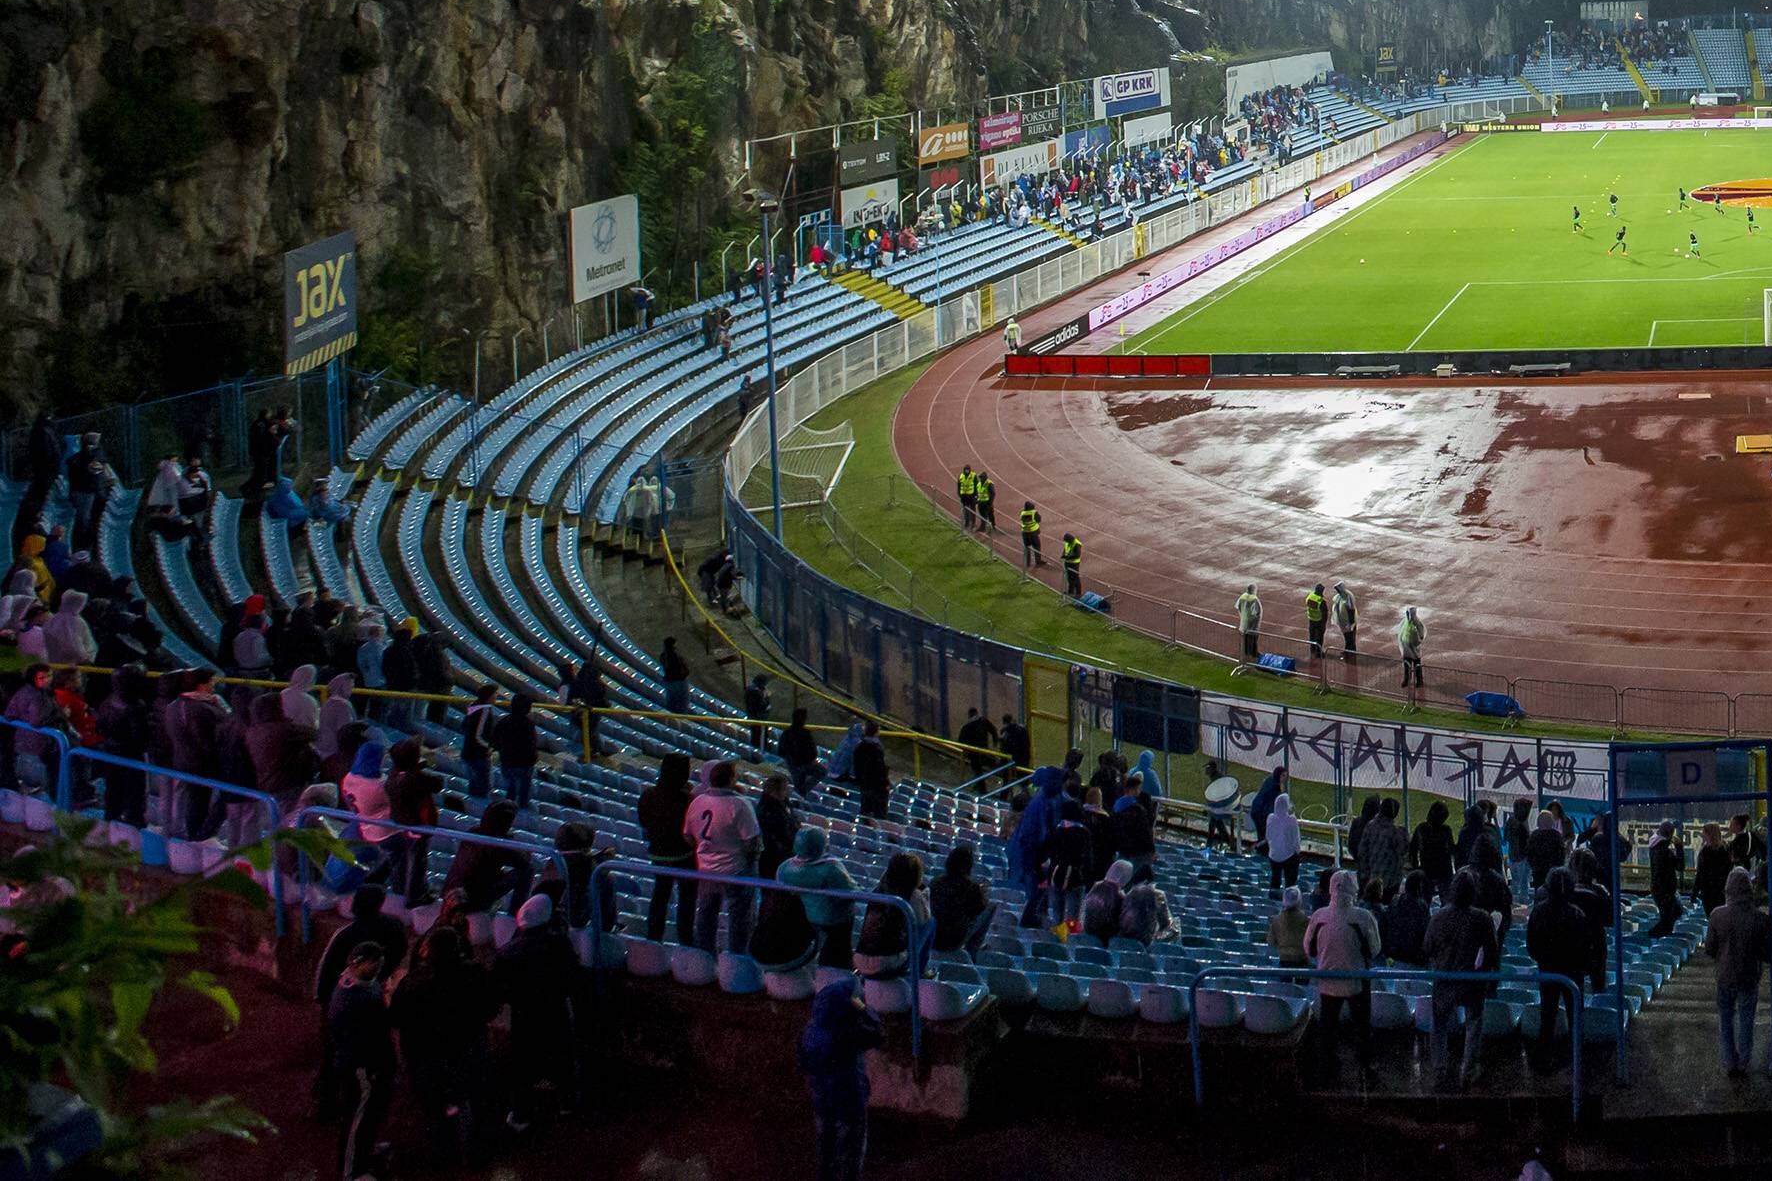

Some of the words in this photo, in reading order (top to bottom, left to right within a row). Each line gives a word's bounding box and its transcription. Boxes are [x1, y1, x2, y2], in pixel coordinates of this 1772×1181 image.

[1117, 79, 1130, 94] GP
[1132, 76, 1152, 91] KRK
[1022, 108, 1059, 124] PORSCHE
[1028, 124, 1053, 136] RIJEKA
[1517, 123, 1540, 131] UNION
[586, 257, 626, 282] Metronet
[1055, 323, 1079, 345] adidas
[1681, 762, 1702, 785] D
